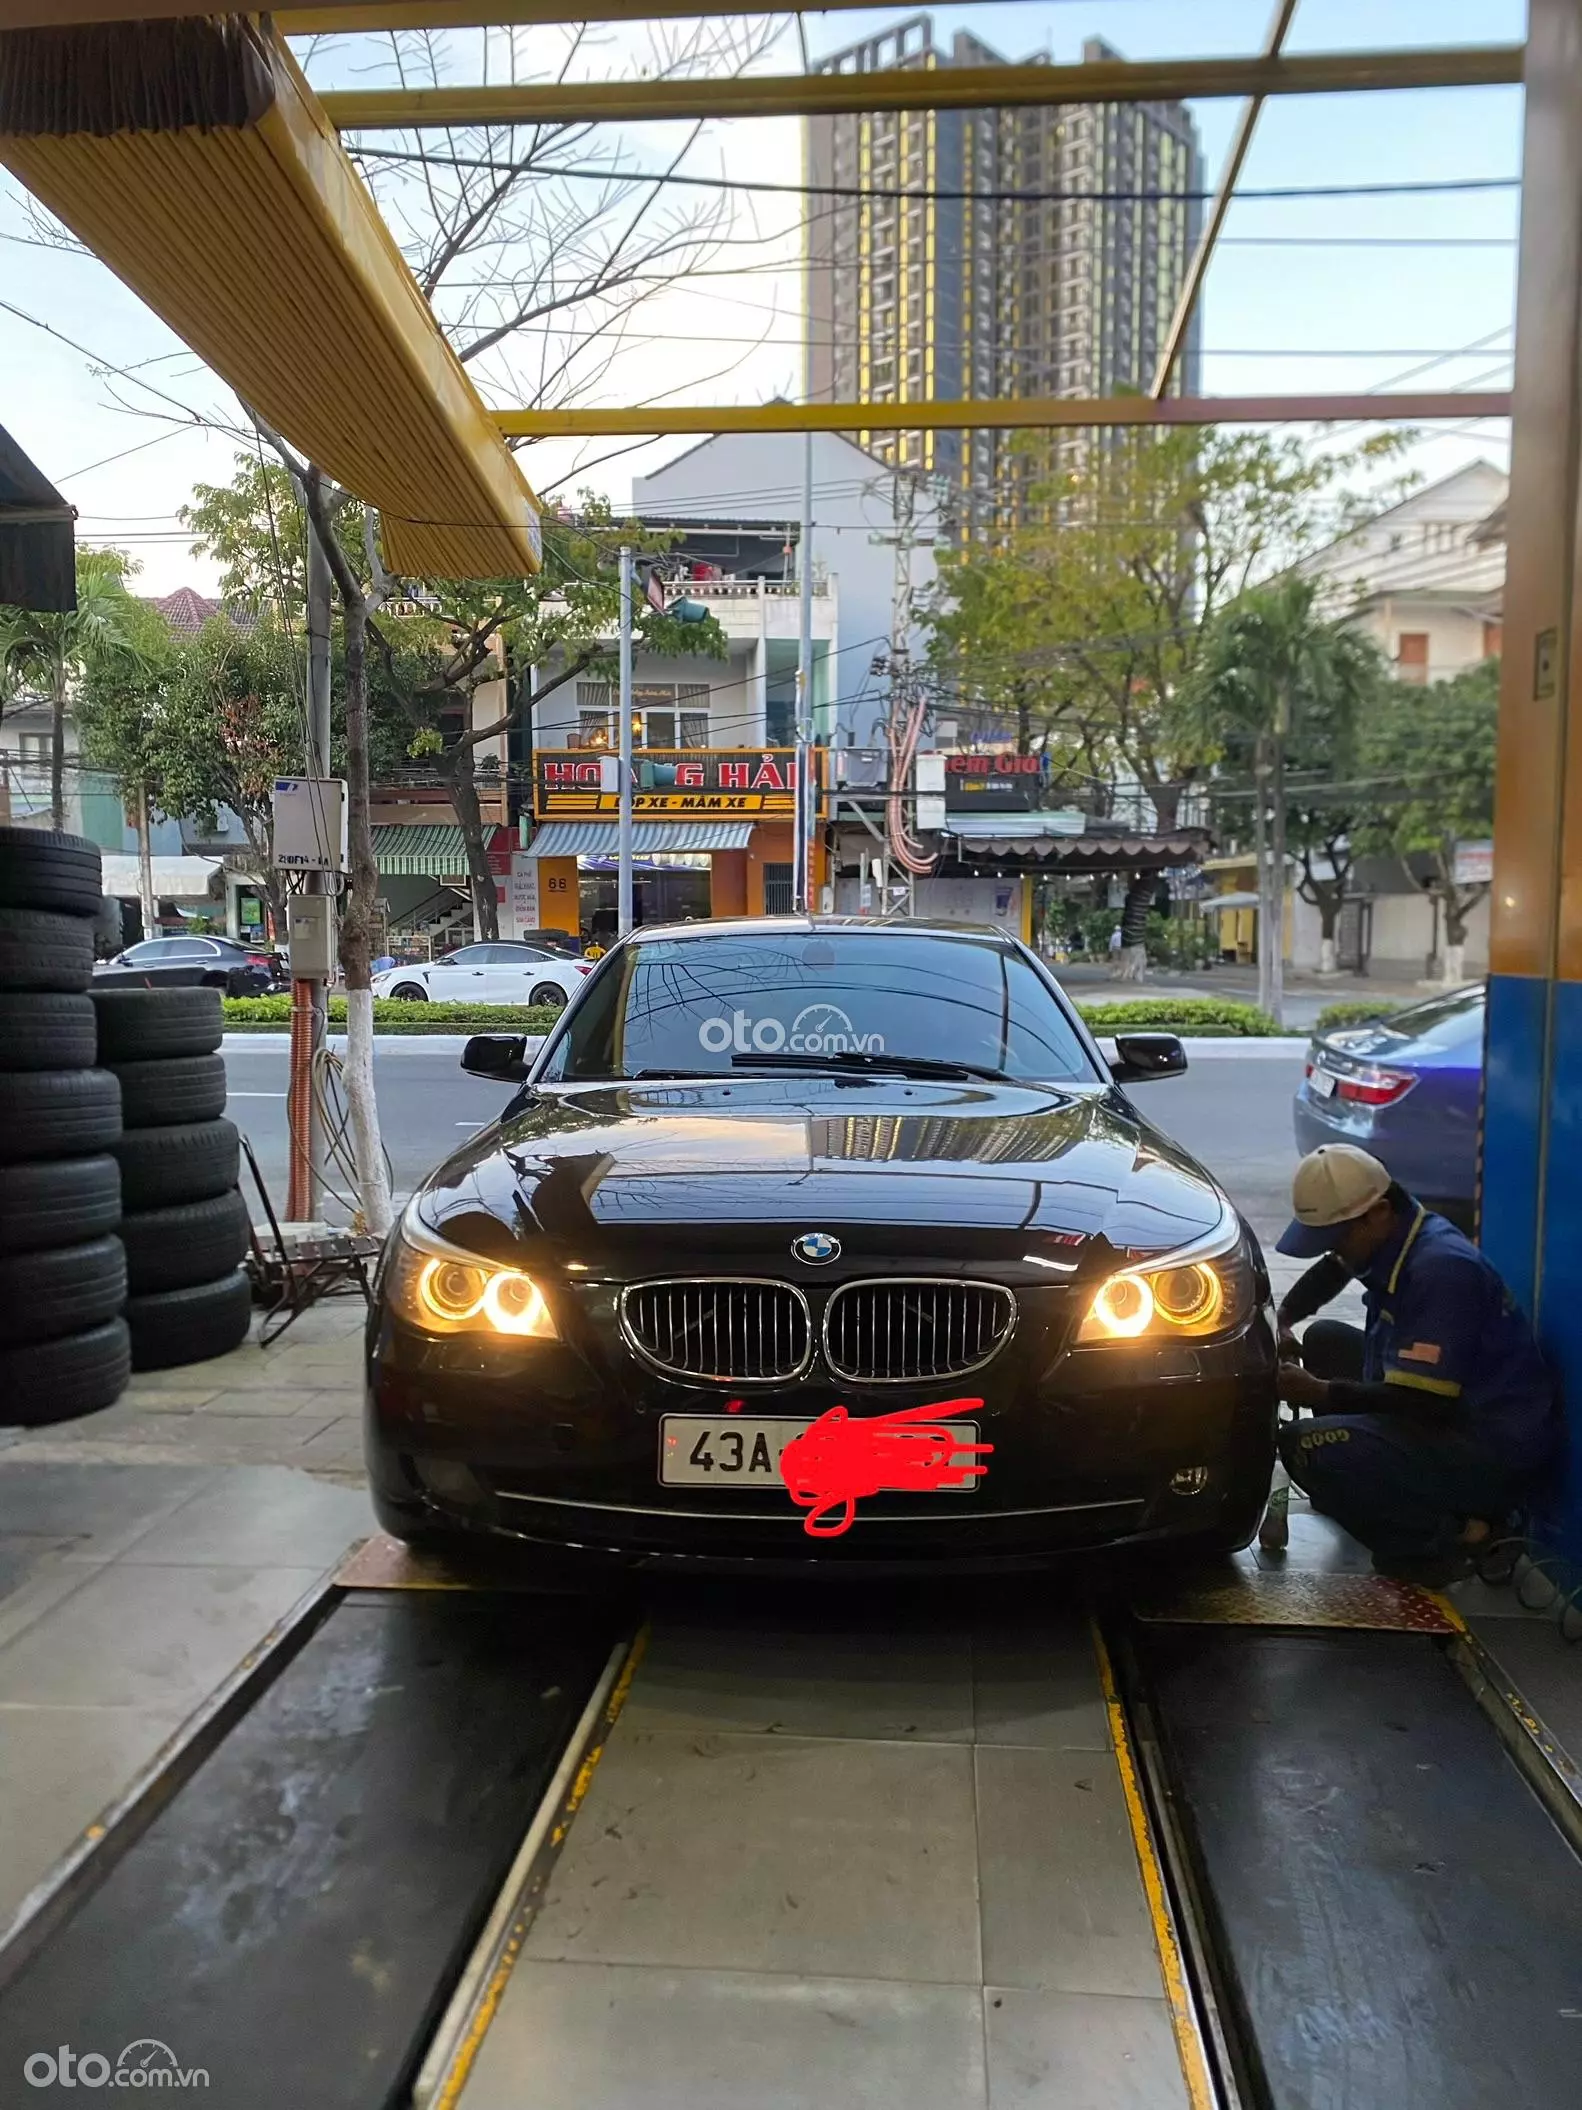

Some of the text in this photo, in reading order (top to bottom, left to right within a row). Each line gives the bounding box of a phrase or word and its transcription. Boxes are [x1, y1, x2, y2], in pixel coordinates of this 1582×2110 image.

[544, 762, 704, 790] HOG
[647, 797, 669, 808] XE
[725, 797, 748, 808] XE
